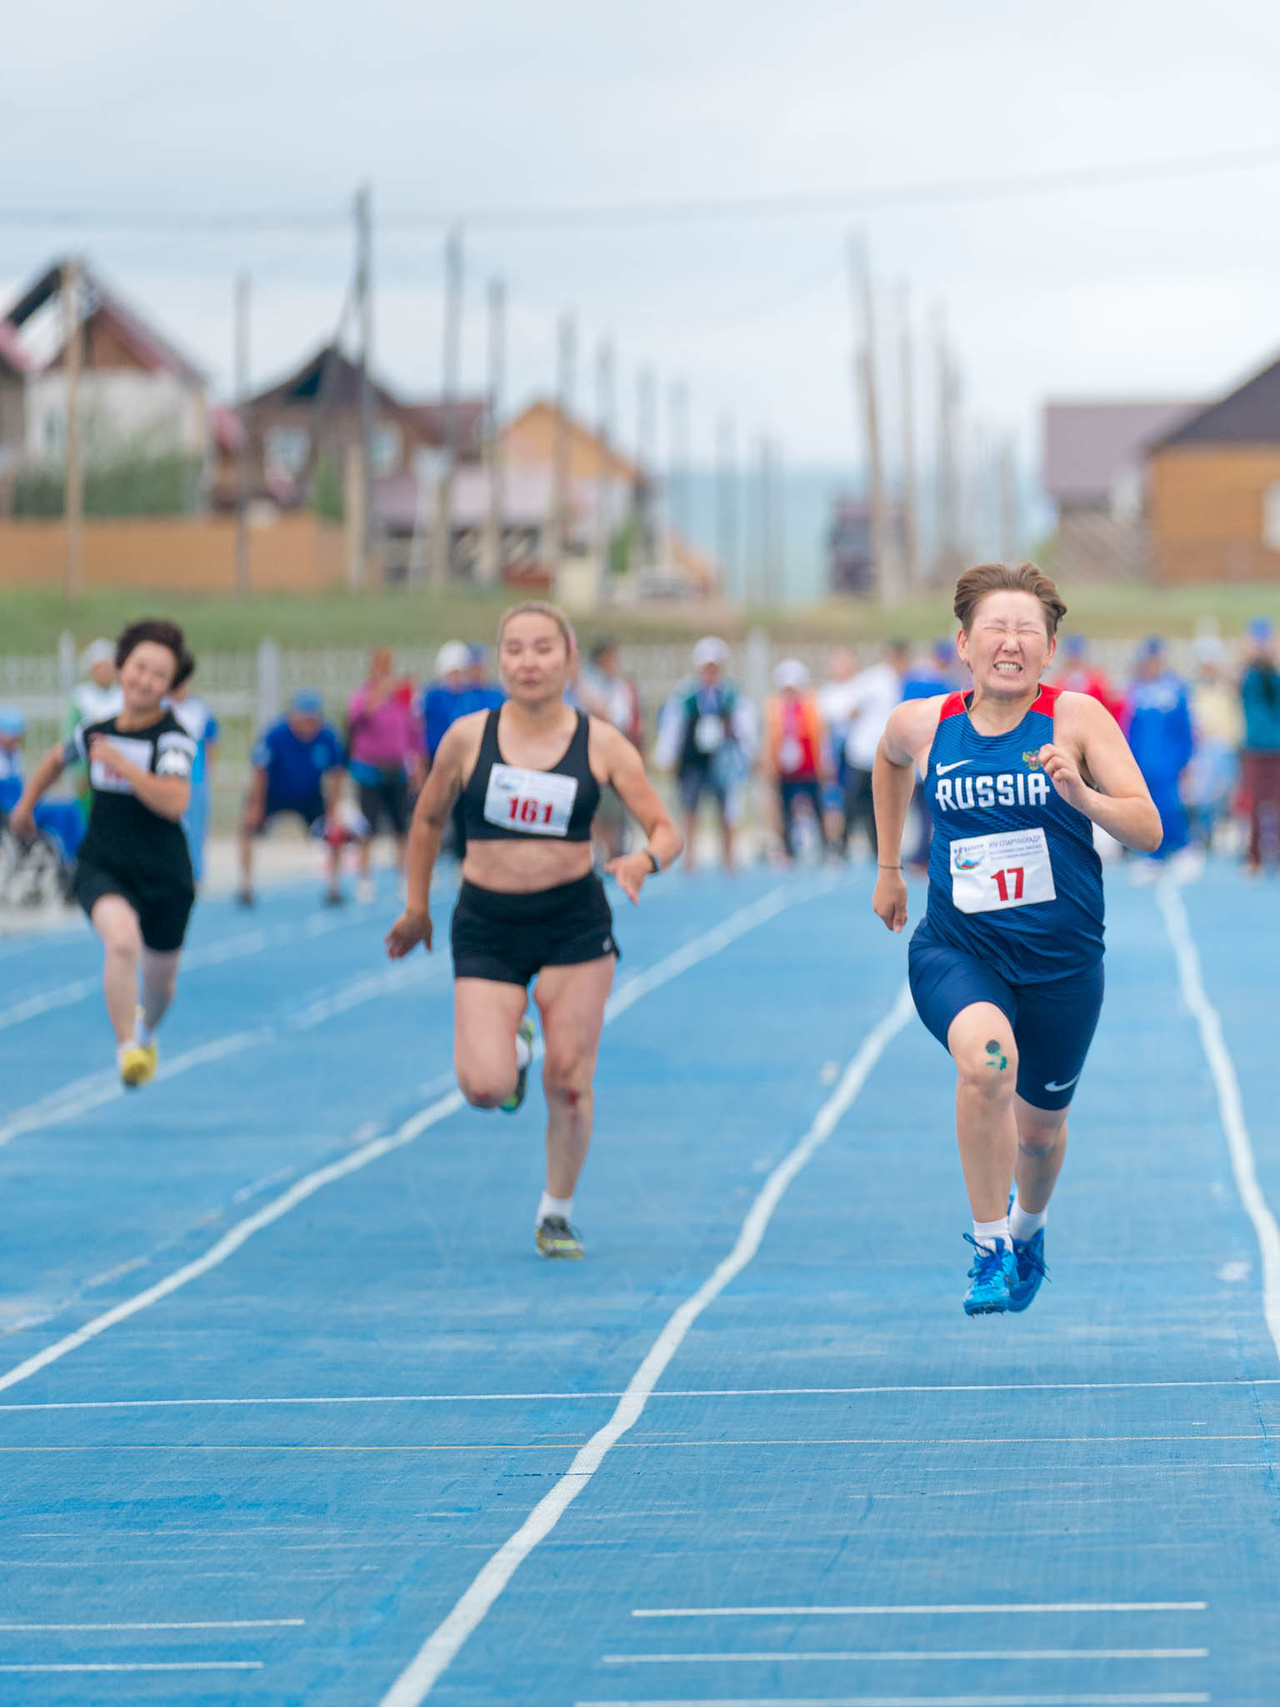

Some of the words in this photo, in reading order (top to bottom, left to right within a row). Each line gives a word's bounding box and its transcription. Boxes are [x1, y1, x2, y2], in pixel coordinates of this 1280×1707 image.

[935, 773, 1050, 811] RUSSIA
[508, 796, 554, 824] 161
[990, 866, 1024, 901] 17
